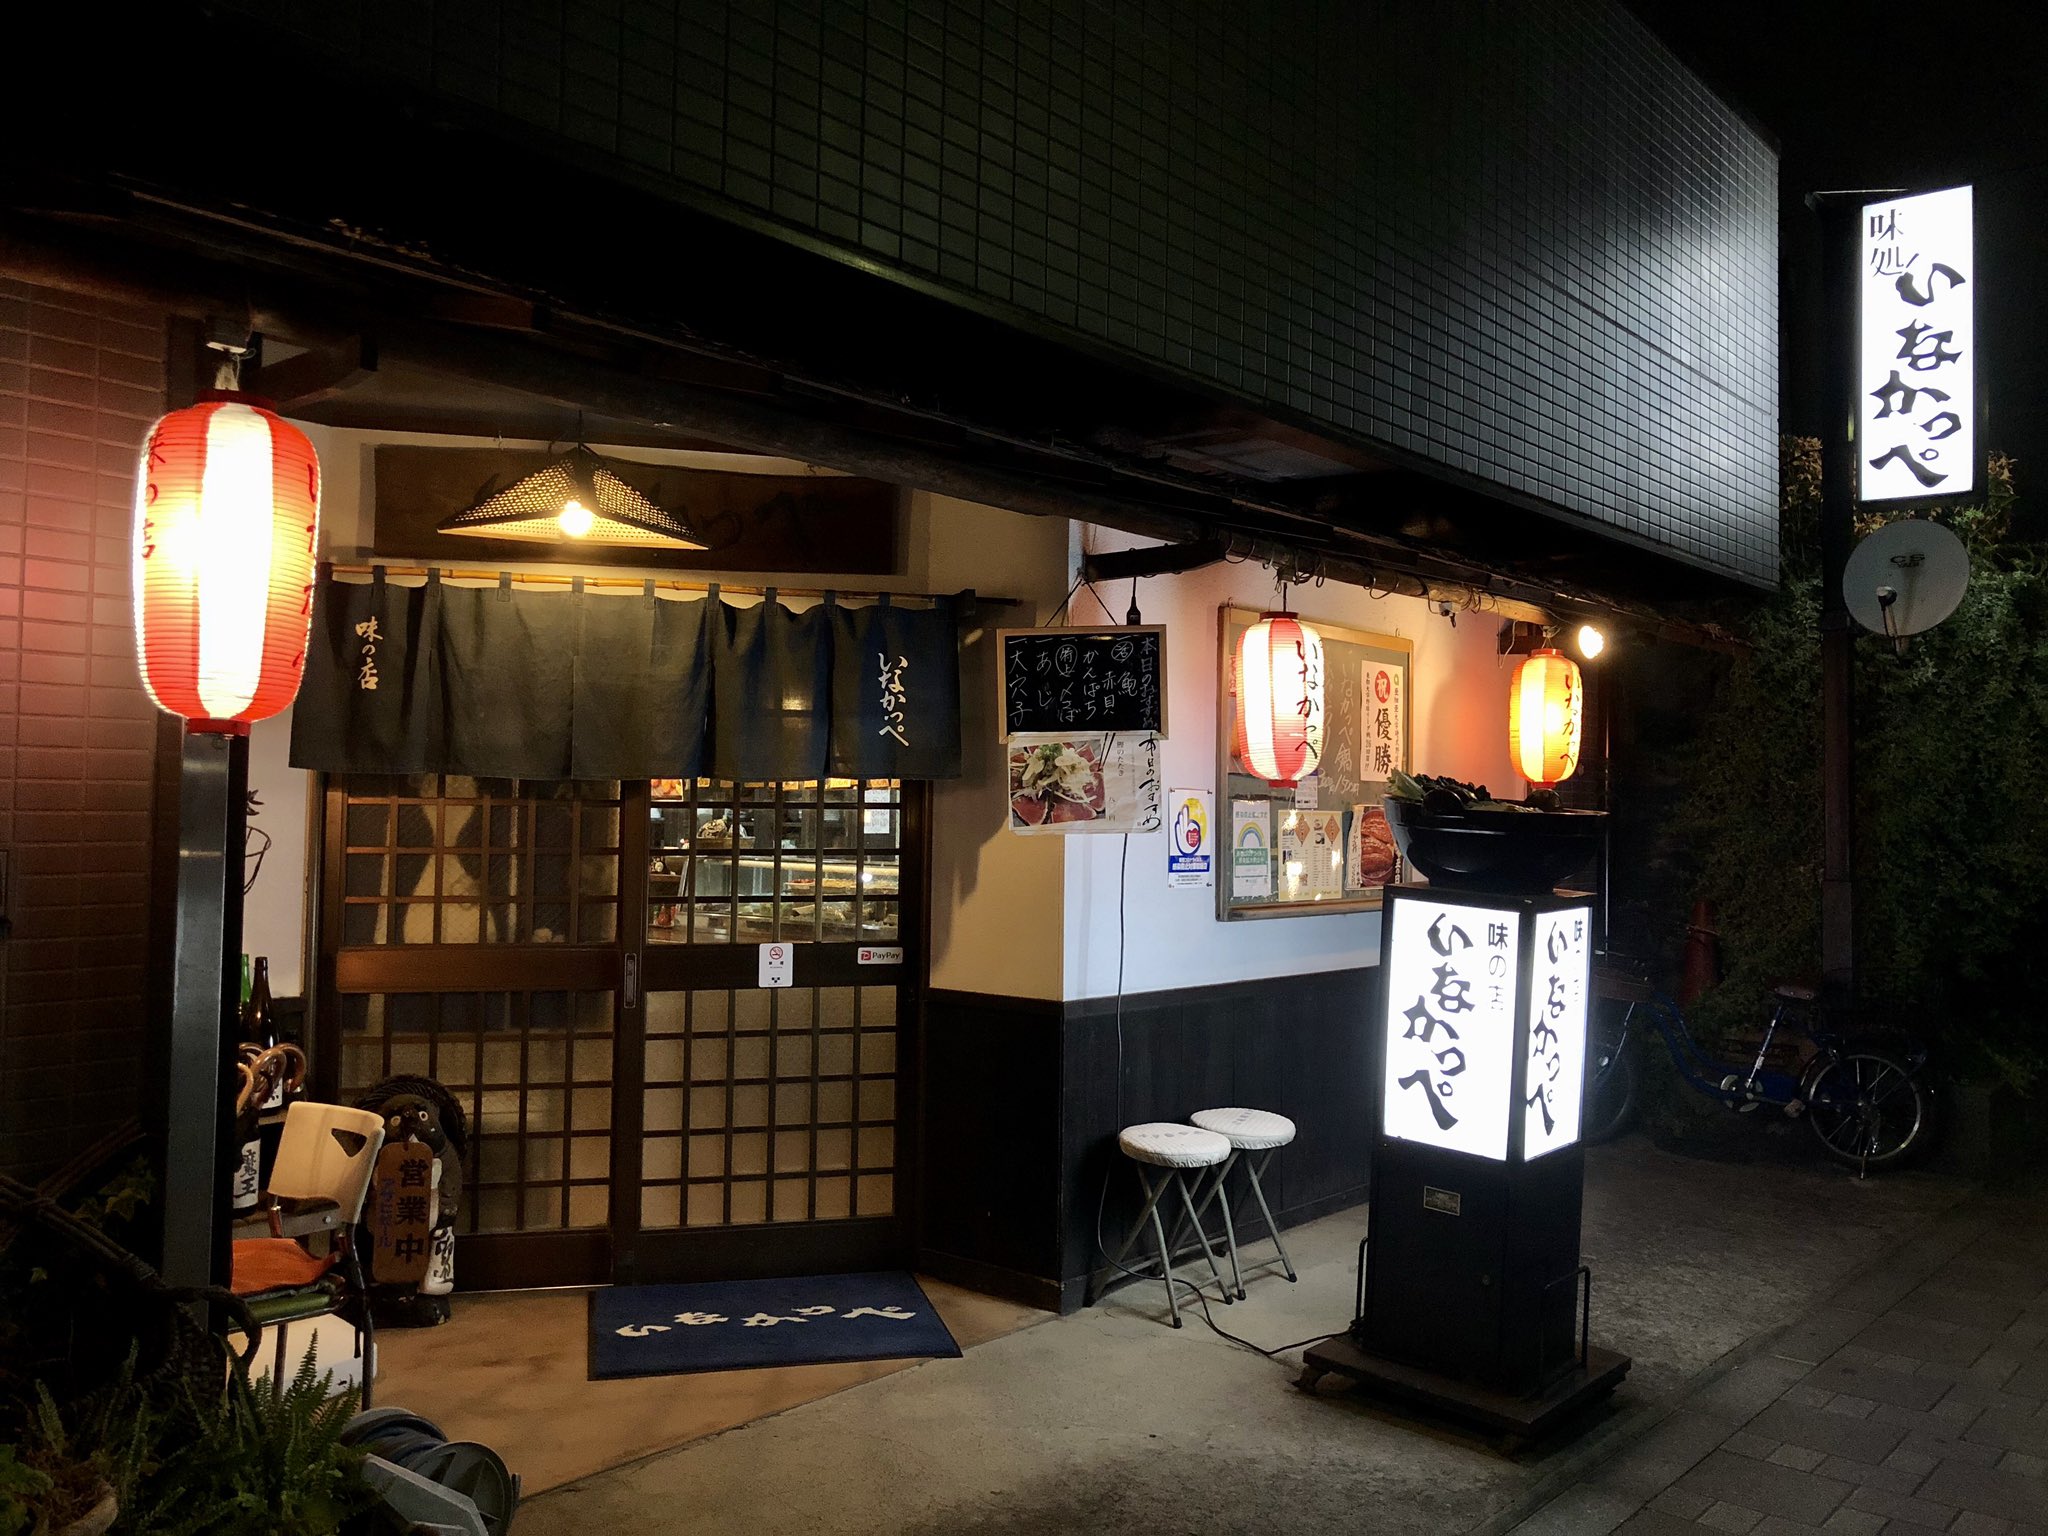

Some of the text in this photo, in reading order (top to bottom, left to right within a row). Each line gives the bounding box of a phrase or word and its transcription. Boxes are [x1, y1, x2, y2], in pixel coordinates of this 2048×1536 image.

[1869, 208, 1905, 278] 味処
[1868, 253, 1967, 489] いなかっぺ
[354, 615, 384, 691] 味の店
[1083, 649, 1100, 721] かんぱち
[1102, 670, 1116, 715] 赤貝
[1376, 673, 1390, 701] 祝
[878, 651, 910, 747] いなかっぺ
[1294, 639, 1321, 760] いなかっぺ
[1559, 674, 1581, 767] いなかっぺ
[1138, 731, 1162, 832] 本日のおすすめ
[1374, 707, 1393, 776] 優勝
[872, 951, 901, 960] PayPay
[1397, 912, 1476, 1131] いなかっぺ
[1525, 920, 1569, 1137] いなかっぺ
[395, 1158, 429, 1263] 営業中
[614, 1304, 917, 1338] いなかっぺ
